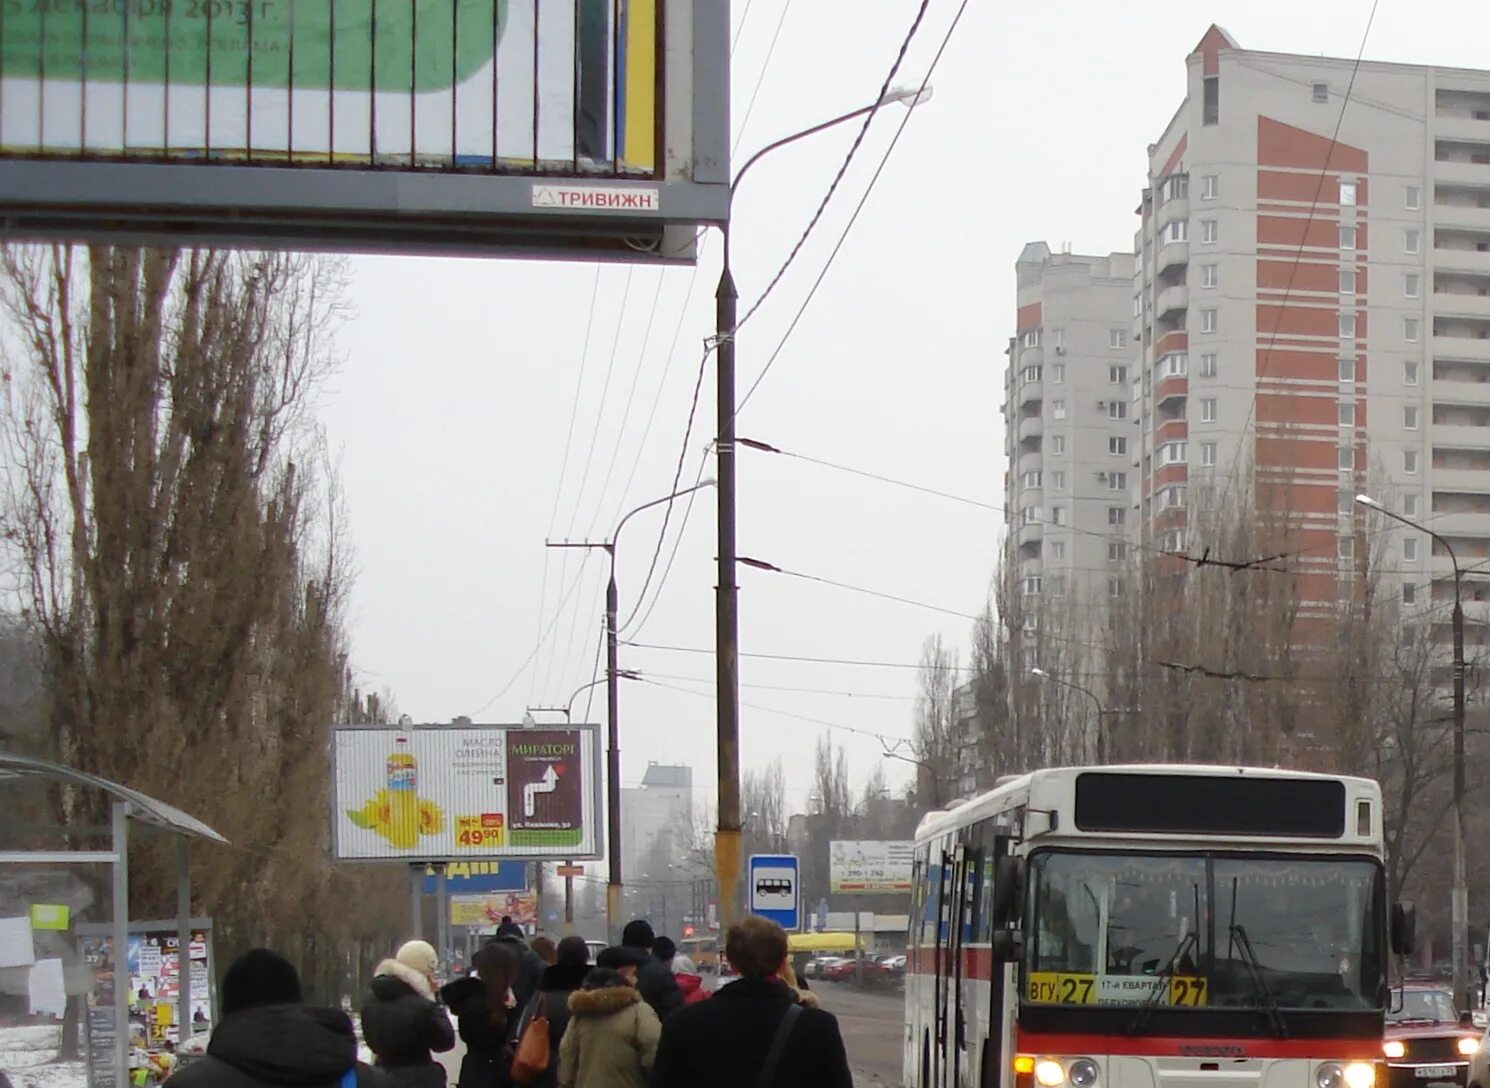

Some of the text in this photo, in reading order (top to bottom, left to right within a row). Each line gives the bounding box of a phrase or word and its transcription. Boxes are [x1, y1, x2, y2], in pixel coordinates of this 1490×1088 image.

[558, 191, 652, 208] ТРИВИЖН
[459, 830, 483, 845] 49
[1062, 978, 1094, 1004] 27
[1174, 979, 1206, 1006] 27
